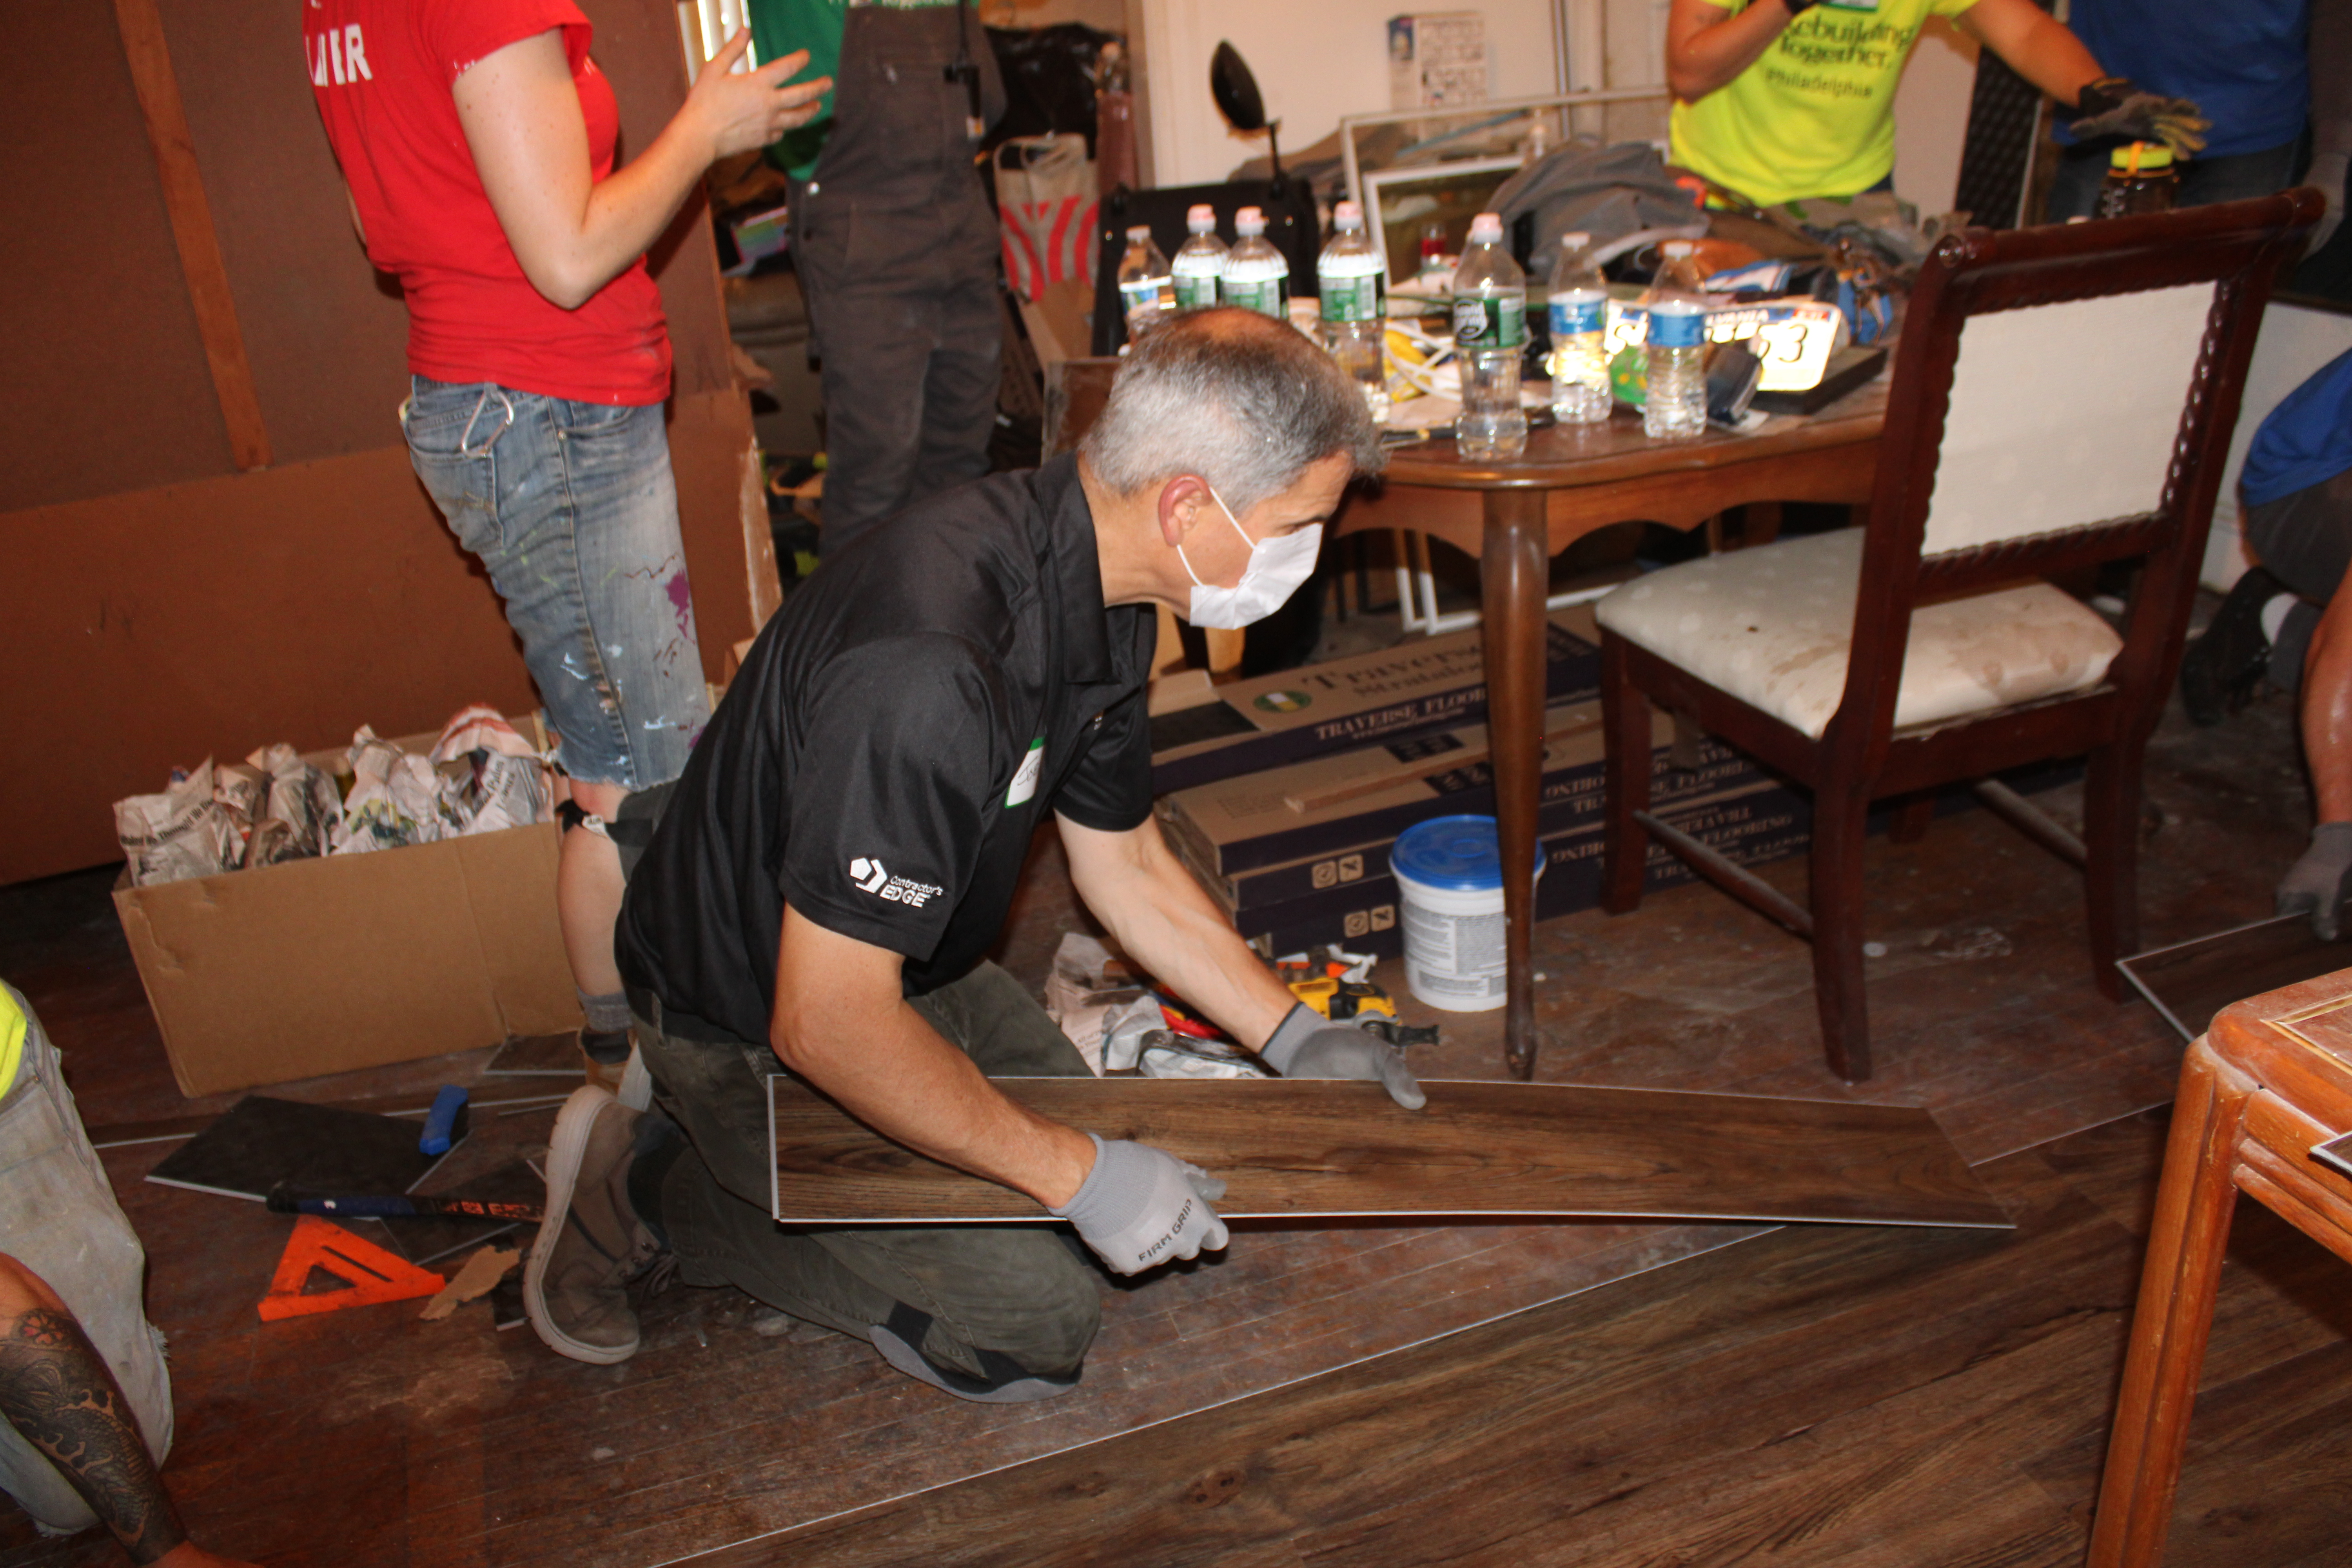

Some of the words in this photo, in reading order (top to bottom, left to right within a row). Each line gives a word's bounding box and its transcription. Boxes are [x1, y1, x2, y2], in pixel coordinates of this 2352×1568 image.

[1316, 704, 1419, 740] TRAVERSE
[1424, 688, 1486, 713] FLOOR
[880, 884, 927, 908] EDGE
[890, 875, 943, 896] Contractor's
[1138, 1233, 1172, 1261] FIRM
